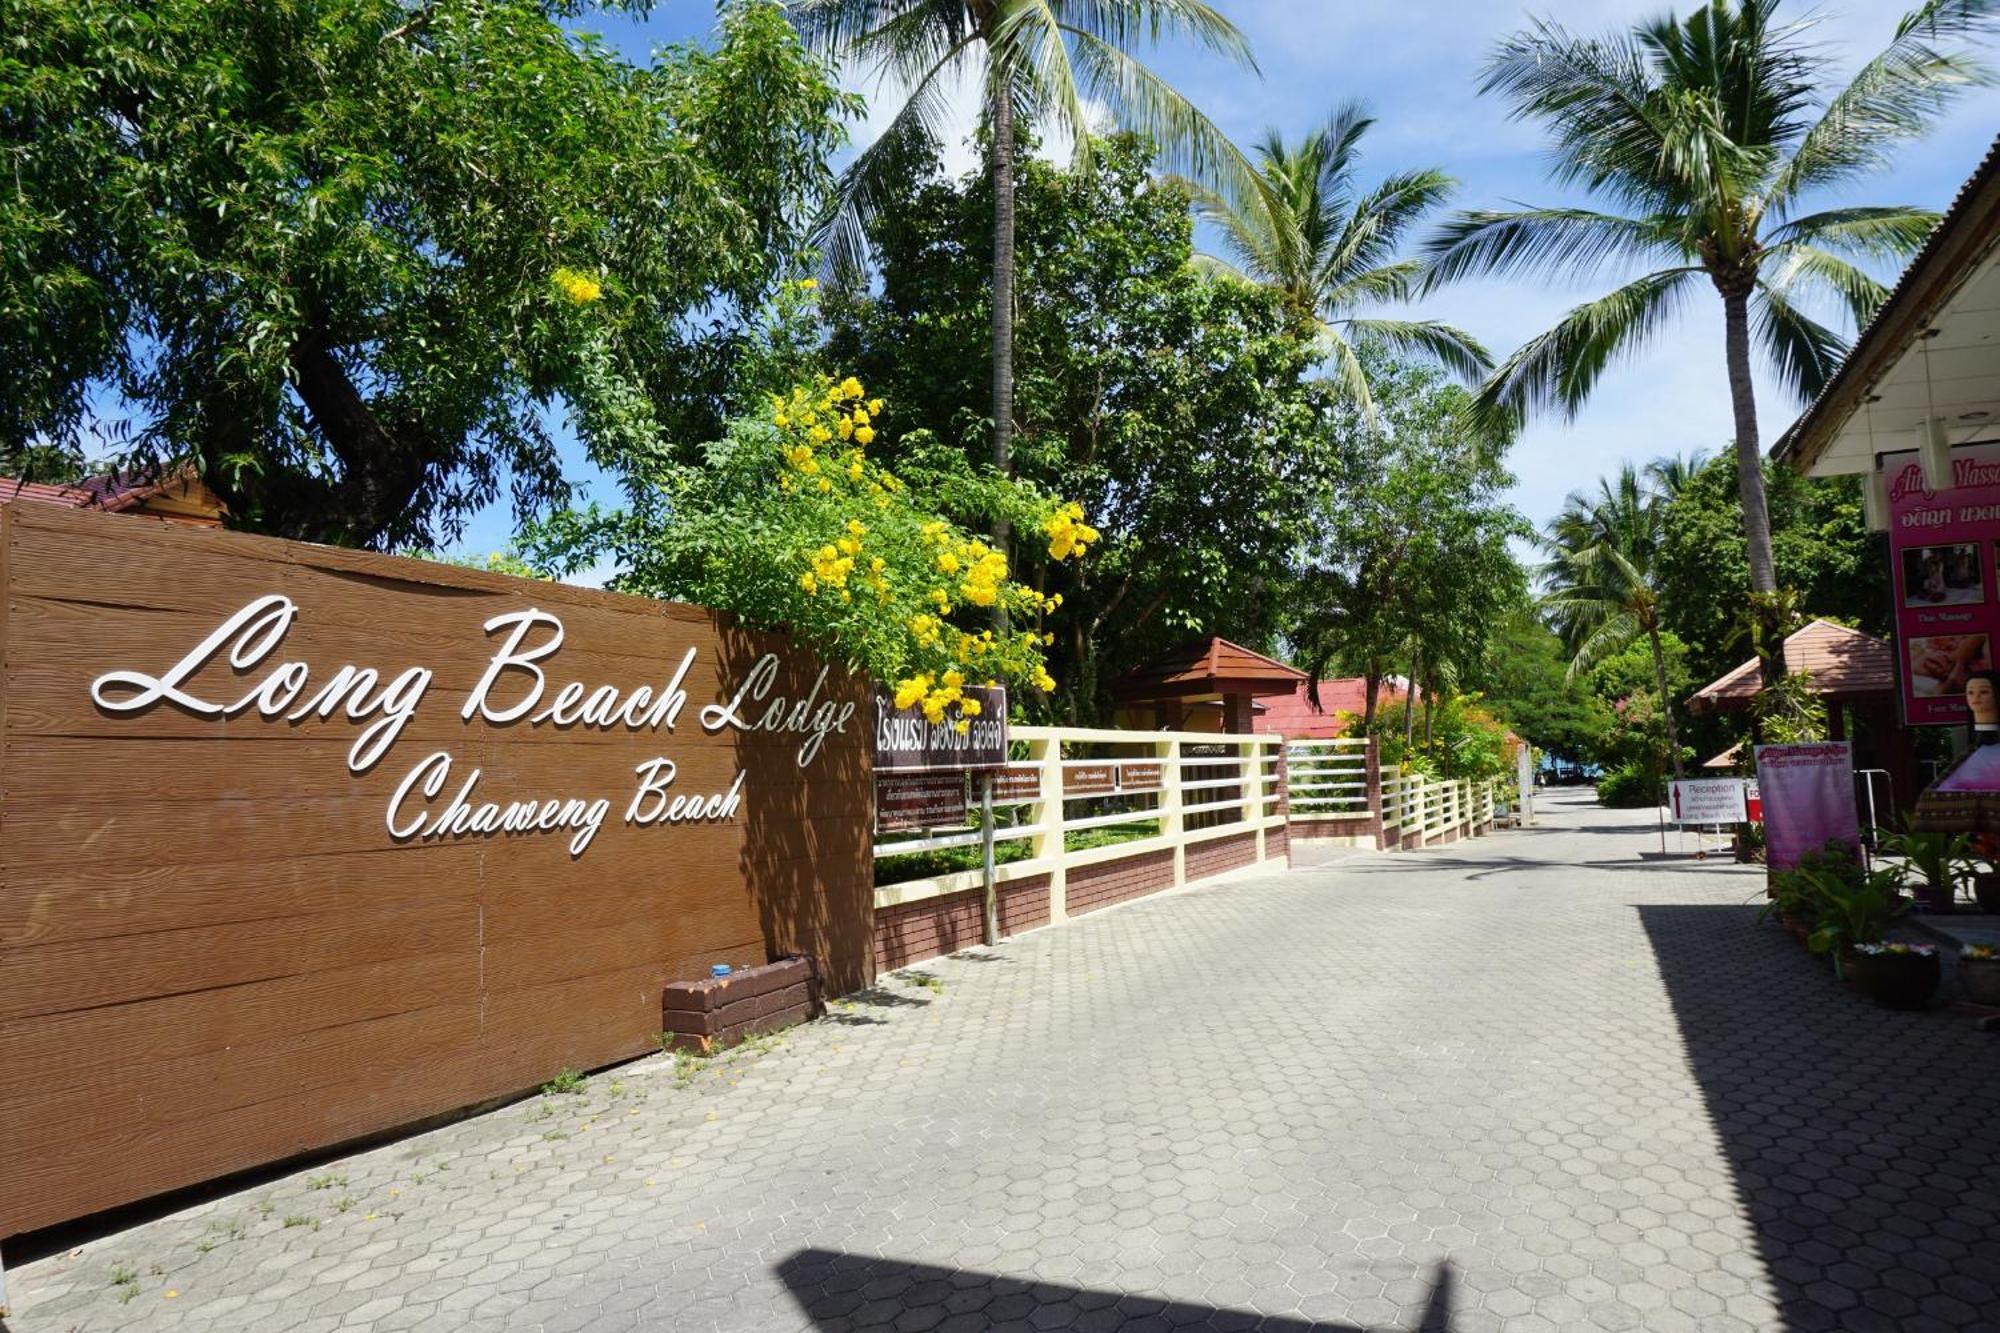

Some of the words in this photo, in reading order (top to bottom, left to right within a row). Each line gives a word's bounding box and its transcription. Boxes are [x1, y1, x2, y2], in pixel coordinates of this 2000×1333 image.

[91, 594, 432, 771] Long
[461, 607, 697, 729] Beach
[700, 653, 855, 768] Lodge
[386, 752, 609, 855] Chaweng
[625, 757, 746, 823] Beach
[1688, 783, 1736, 795] Reception
